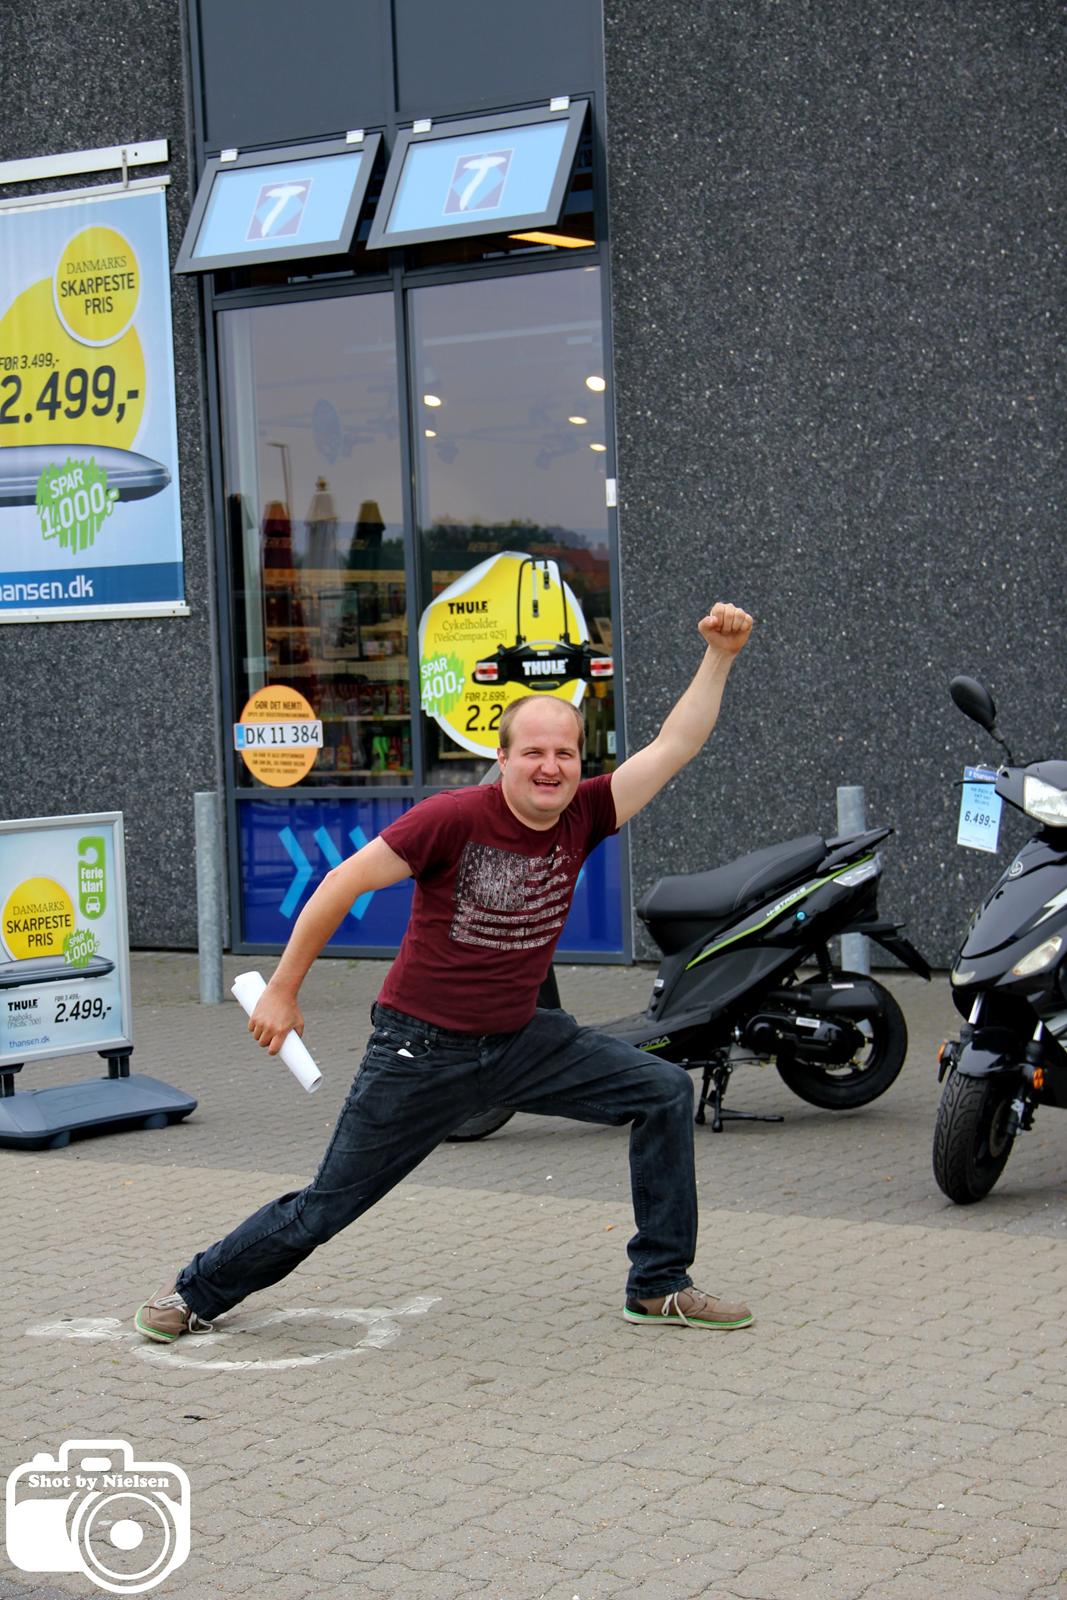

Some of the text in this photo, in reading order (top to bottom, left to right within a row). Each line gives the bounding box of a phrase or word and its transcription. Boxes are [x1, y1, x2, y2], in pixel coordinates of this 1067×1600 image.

[66, 255, 128, 275] DANMARKS
[60, 272, 136, 299] SKARPESTE
[84, 296, 113, 315] PRIS
[20, 352, 60, 369] 3.499,-
[0, 365, 139, 424] 2.499,-
[50, 468, 84, 499] SPAR
[42, 482, 119, 538] 1.000,-
[448, 601, 488, 615] THULE
[441, 618, 498, 632] Cykelholder
[421, 657, 448, 680] SPAR
[522, 659, 567, 676] THULE
[421, 671, 466, 702] 400,-
[464, 692, 481, 703] FØR
[465, 703, 504, 731] 2.2
[246, 725, 319, 745] DK 11 384
[964, 810, 997, 829] 6.499,-
[12, 901, 65, 916] DANMARKS
[6, 914, 72, 934] SKARPESTE
[27, 932, 54, 948] PRIS
[8, 999, 39, 1012] THULE
[54, 998, 112, 1023] 2.499,-
